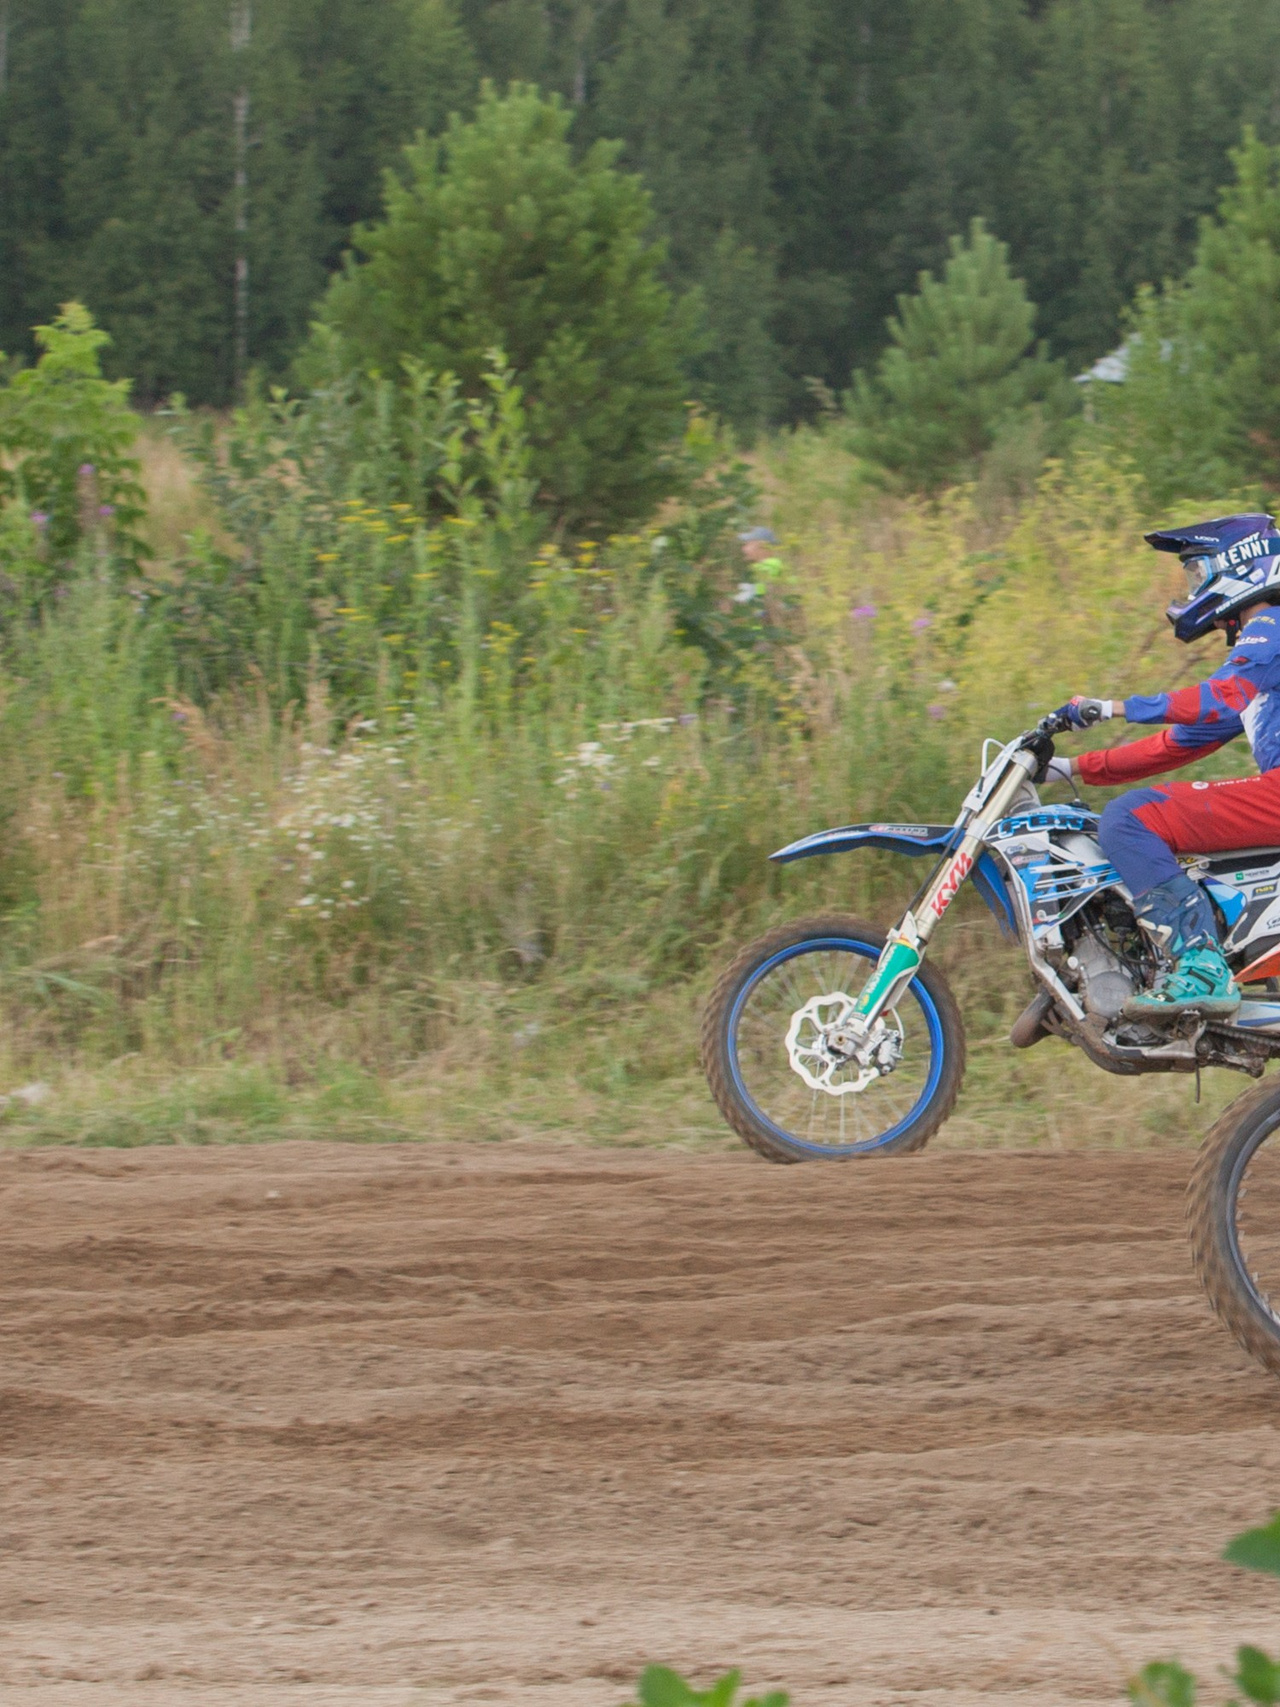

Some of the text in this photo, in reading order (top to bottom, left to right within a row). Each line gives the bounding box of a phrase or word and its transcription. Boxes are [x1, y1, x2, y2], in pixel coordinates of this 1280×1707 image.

[1217, 539, 1270, 569] KENNY
[998, 814, 1084, 839] FBR
[930, 852, 974, 919] KYB
